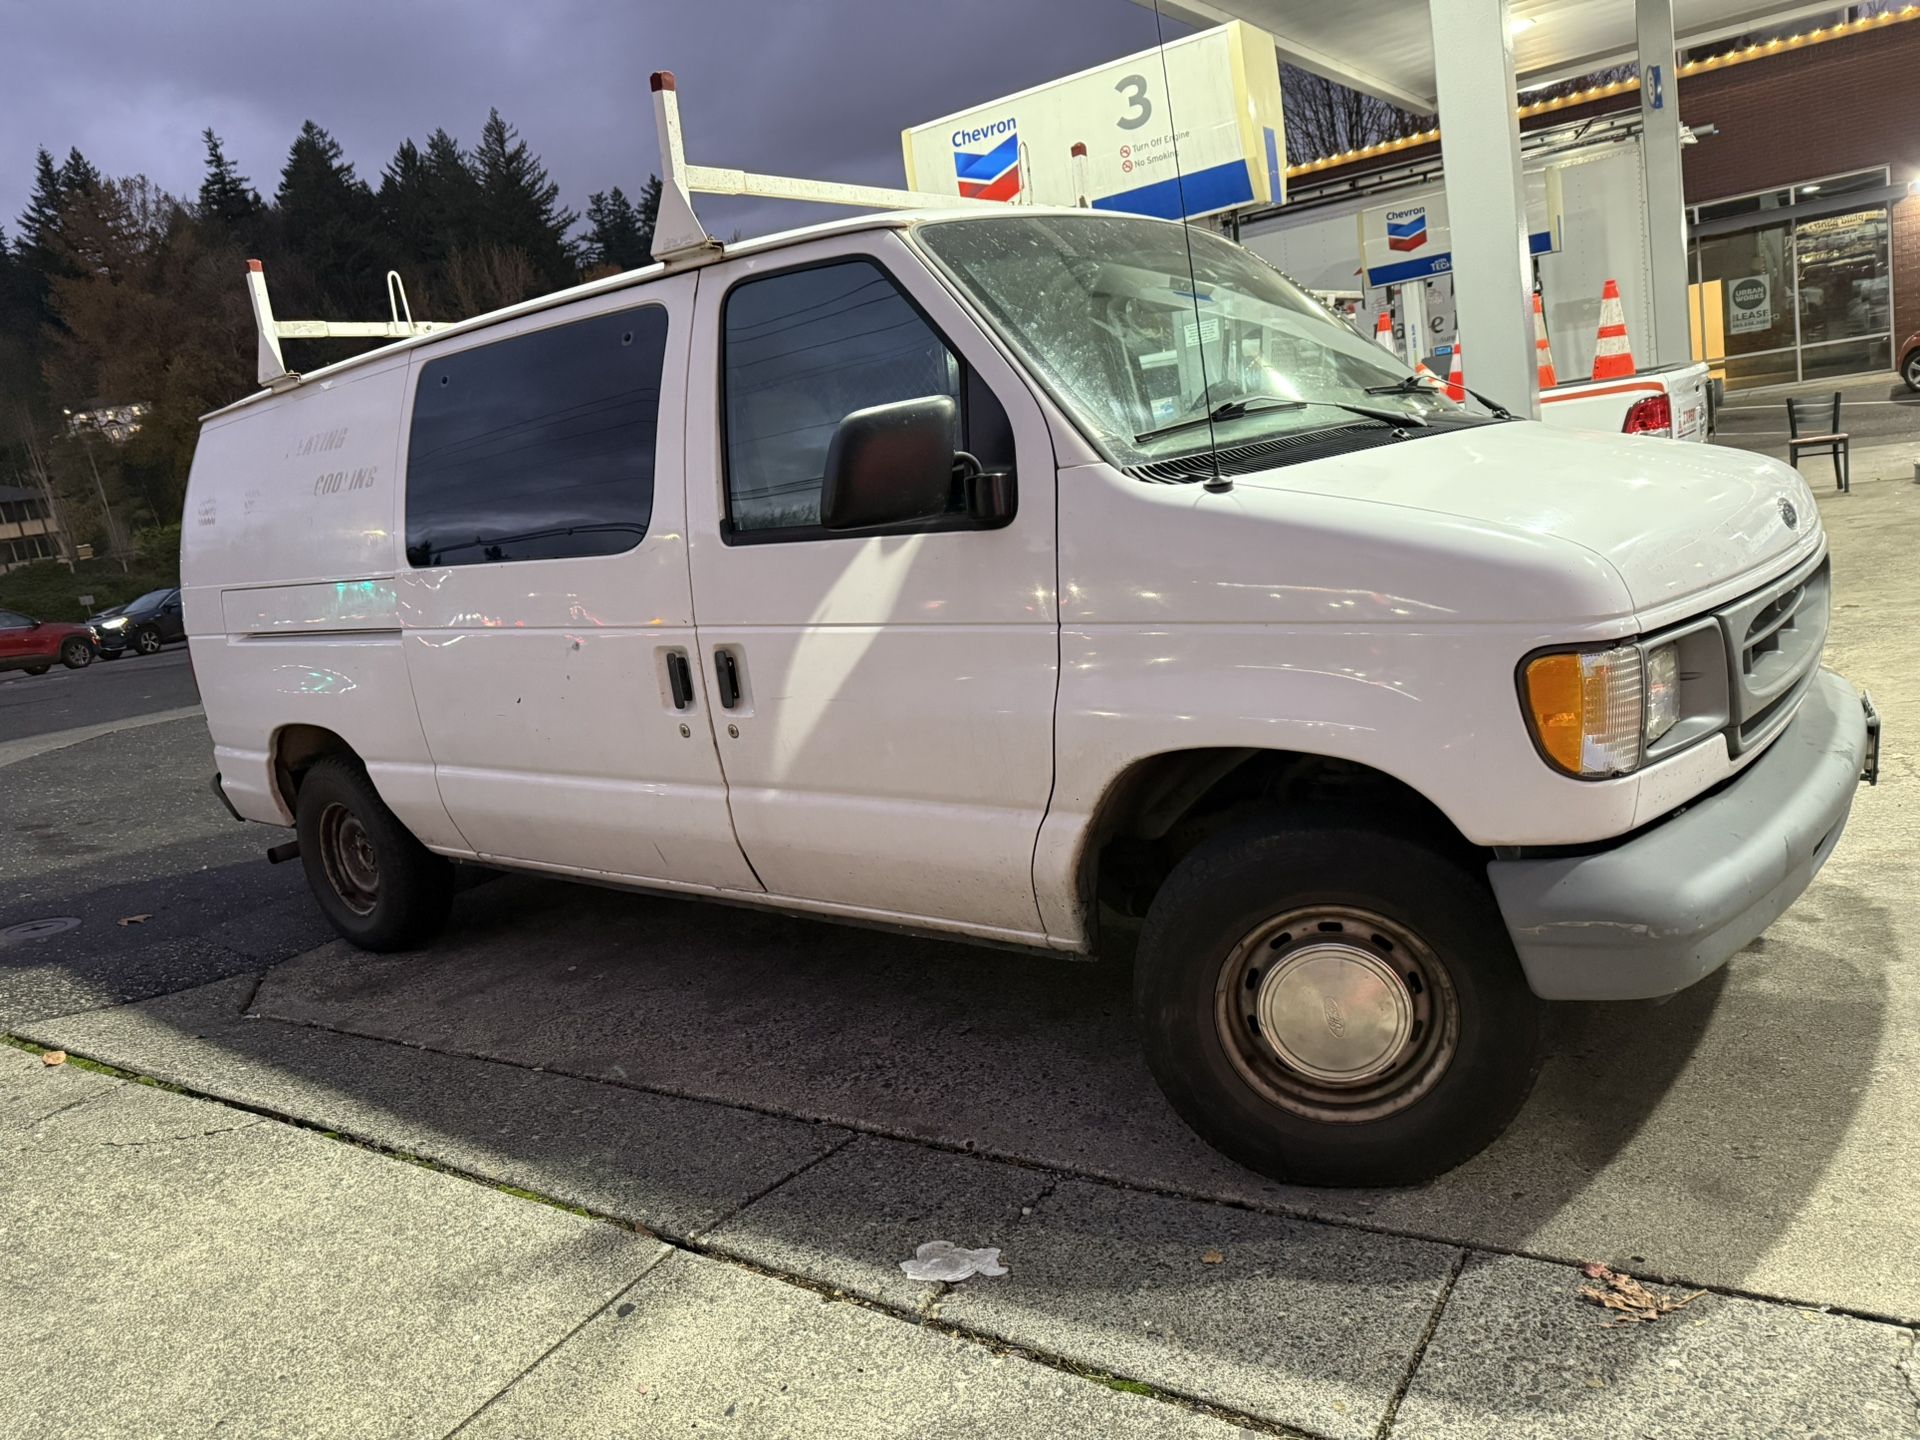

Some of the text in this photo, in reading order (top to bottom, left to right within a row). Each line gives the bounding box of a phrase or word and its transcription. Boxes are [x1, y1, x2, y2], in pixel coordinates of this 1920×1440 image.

[1114, 74, 1152, 130] 3
[952, 117, 1017, 147] Chevron
[1132, 142, 1149, 153] Turn
[1150, 136, 1163, 148] Off
[1134, 159, 1146, 168] No
[1386, 206, 1425, 221] Chevron
[1735, 286, 1764, 297] URBAN
[1735, 294, 1765, 303] WORKS
